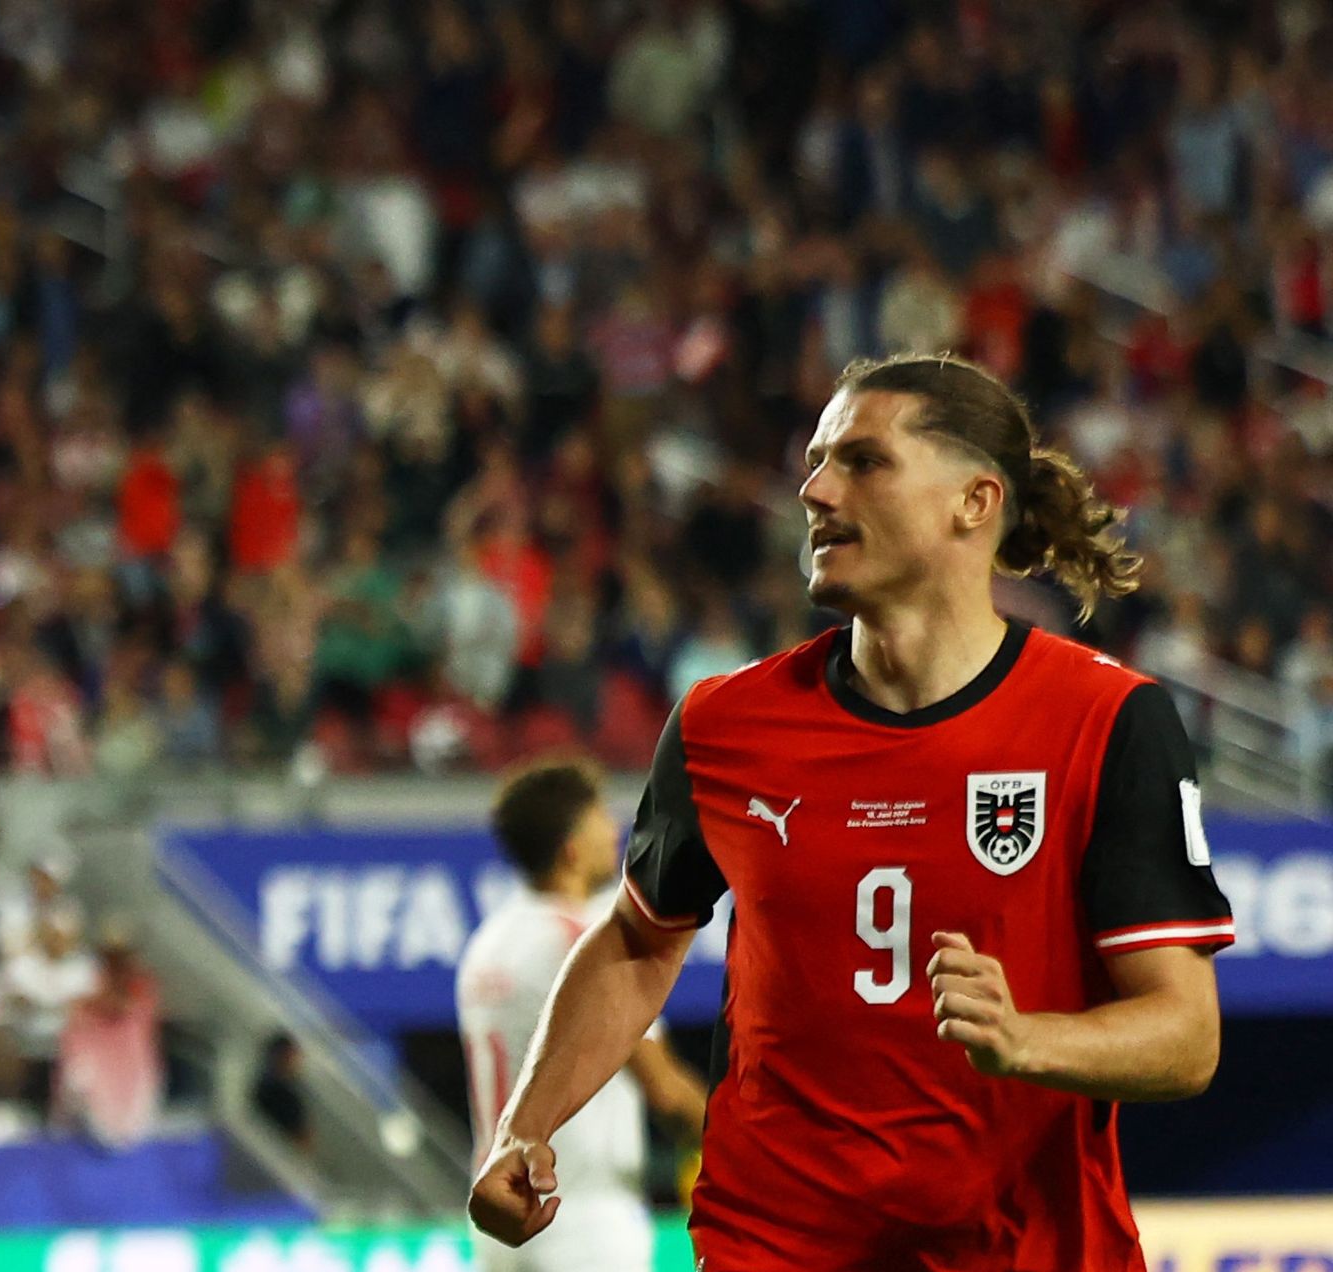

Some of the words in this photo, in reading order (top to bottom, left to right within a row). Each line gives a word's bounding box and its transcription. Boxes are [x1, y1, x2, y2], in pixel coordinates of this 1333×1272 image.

[989, 780, 1022, 790] ÖFB
[257, 862, 468, 974] FIFA
[854, 866, 913, 1005] 9
